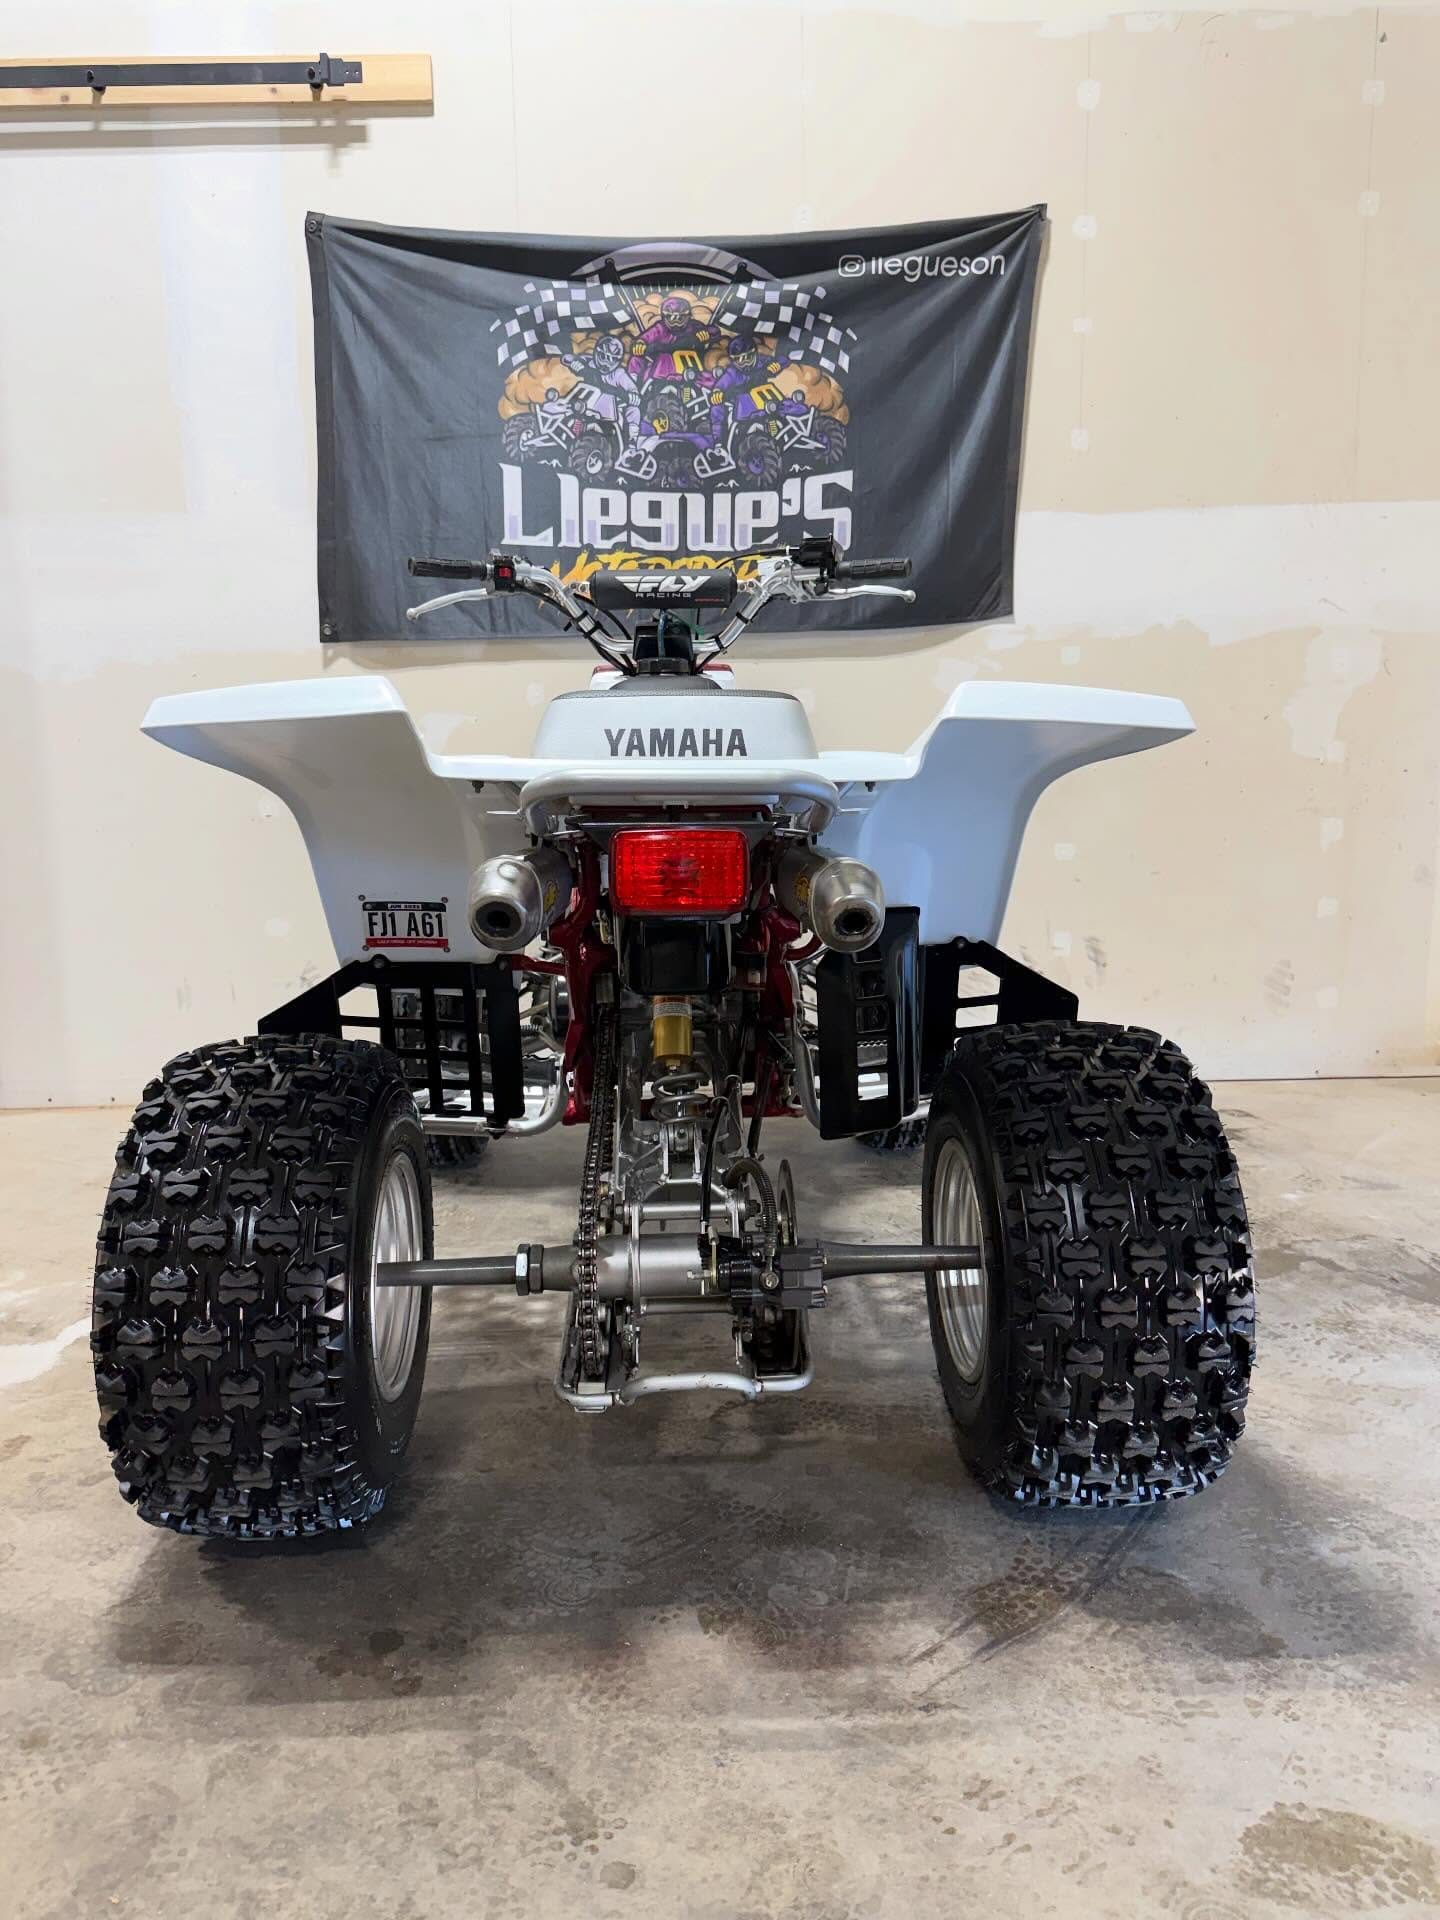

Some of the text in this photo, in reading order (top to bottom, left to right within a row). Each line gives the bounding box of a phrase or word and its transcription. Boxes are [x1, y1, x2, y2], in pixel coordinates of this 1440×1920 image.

[615, 575, 712, 593] FLY
[603, 728, 748, 757] YAMAHA
[367, 911, 444, 938] FJ1 A61
